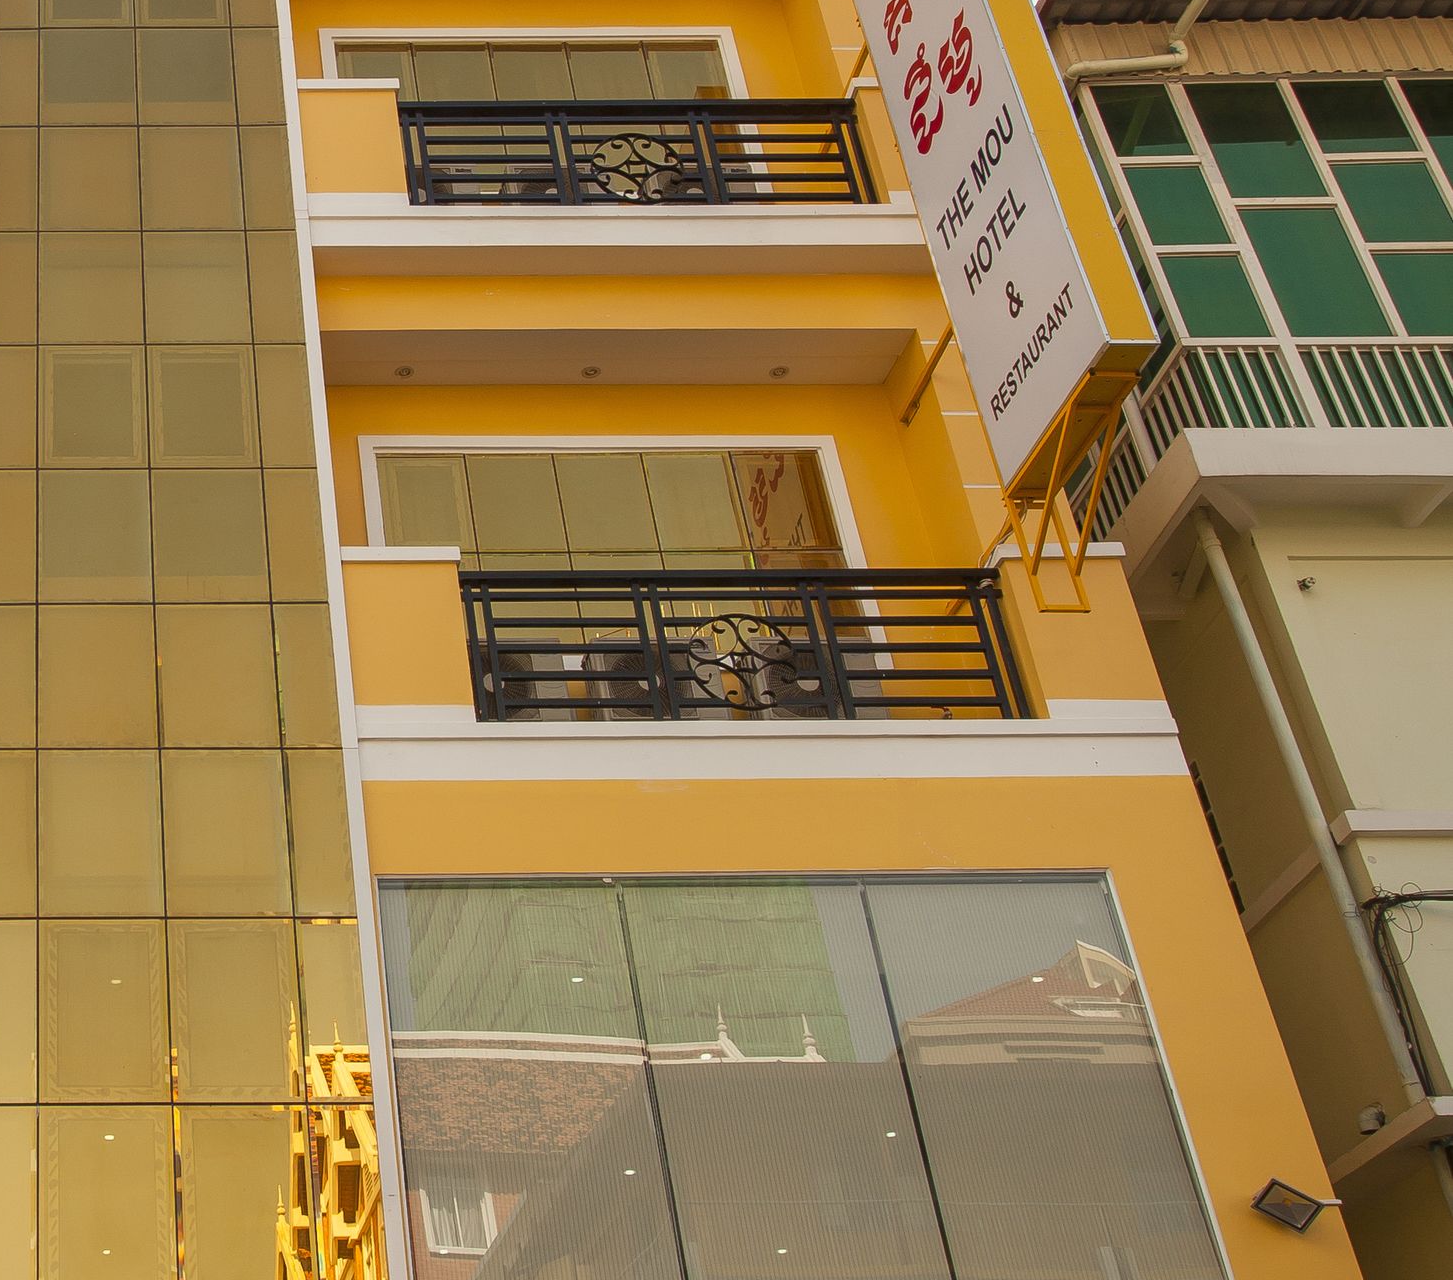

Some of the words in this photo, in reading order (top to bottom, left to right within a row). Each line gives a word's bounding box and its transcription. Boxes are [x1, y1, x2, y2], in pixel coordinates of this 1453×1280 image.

[936, 177, 975, 251] THE
[970, 102, 1015, 194] MOU
[963, 187, 1027, 296] HOTEL
[1005, 280, 1024, 319] &
[990, 282, 1074, 421] RESTAURANT
